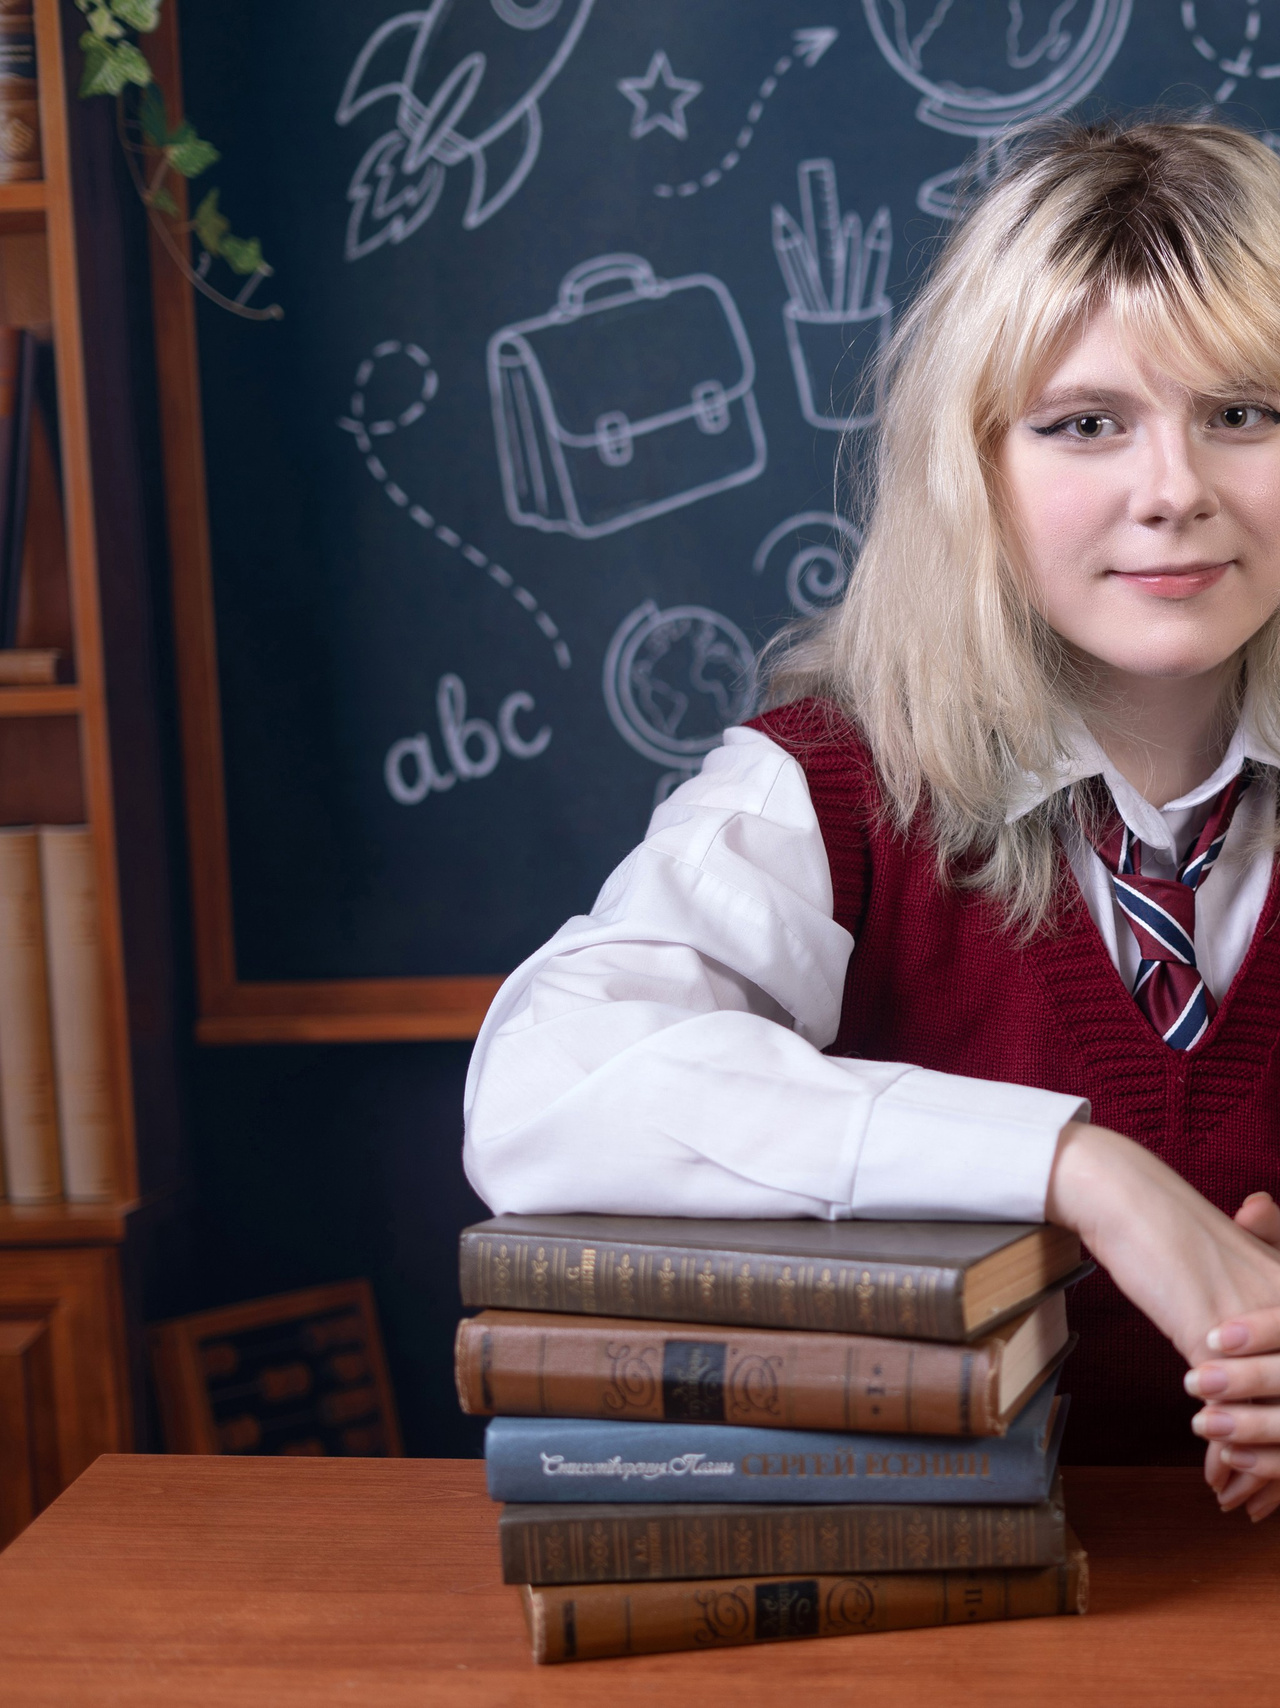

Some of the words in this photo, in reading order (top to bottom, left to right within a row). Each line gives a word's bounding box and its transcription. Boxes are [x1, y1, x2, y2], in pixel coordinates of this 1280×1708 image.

[384, 673, 552, 805] abc
[741, 1447, 857, 1478] СЕРГЕЙ
[864, 1453, 991, 1478] ЕСЕНИН
